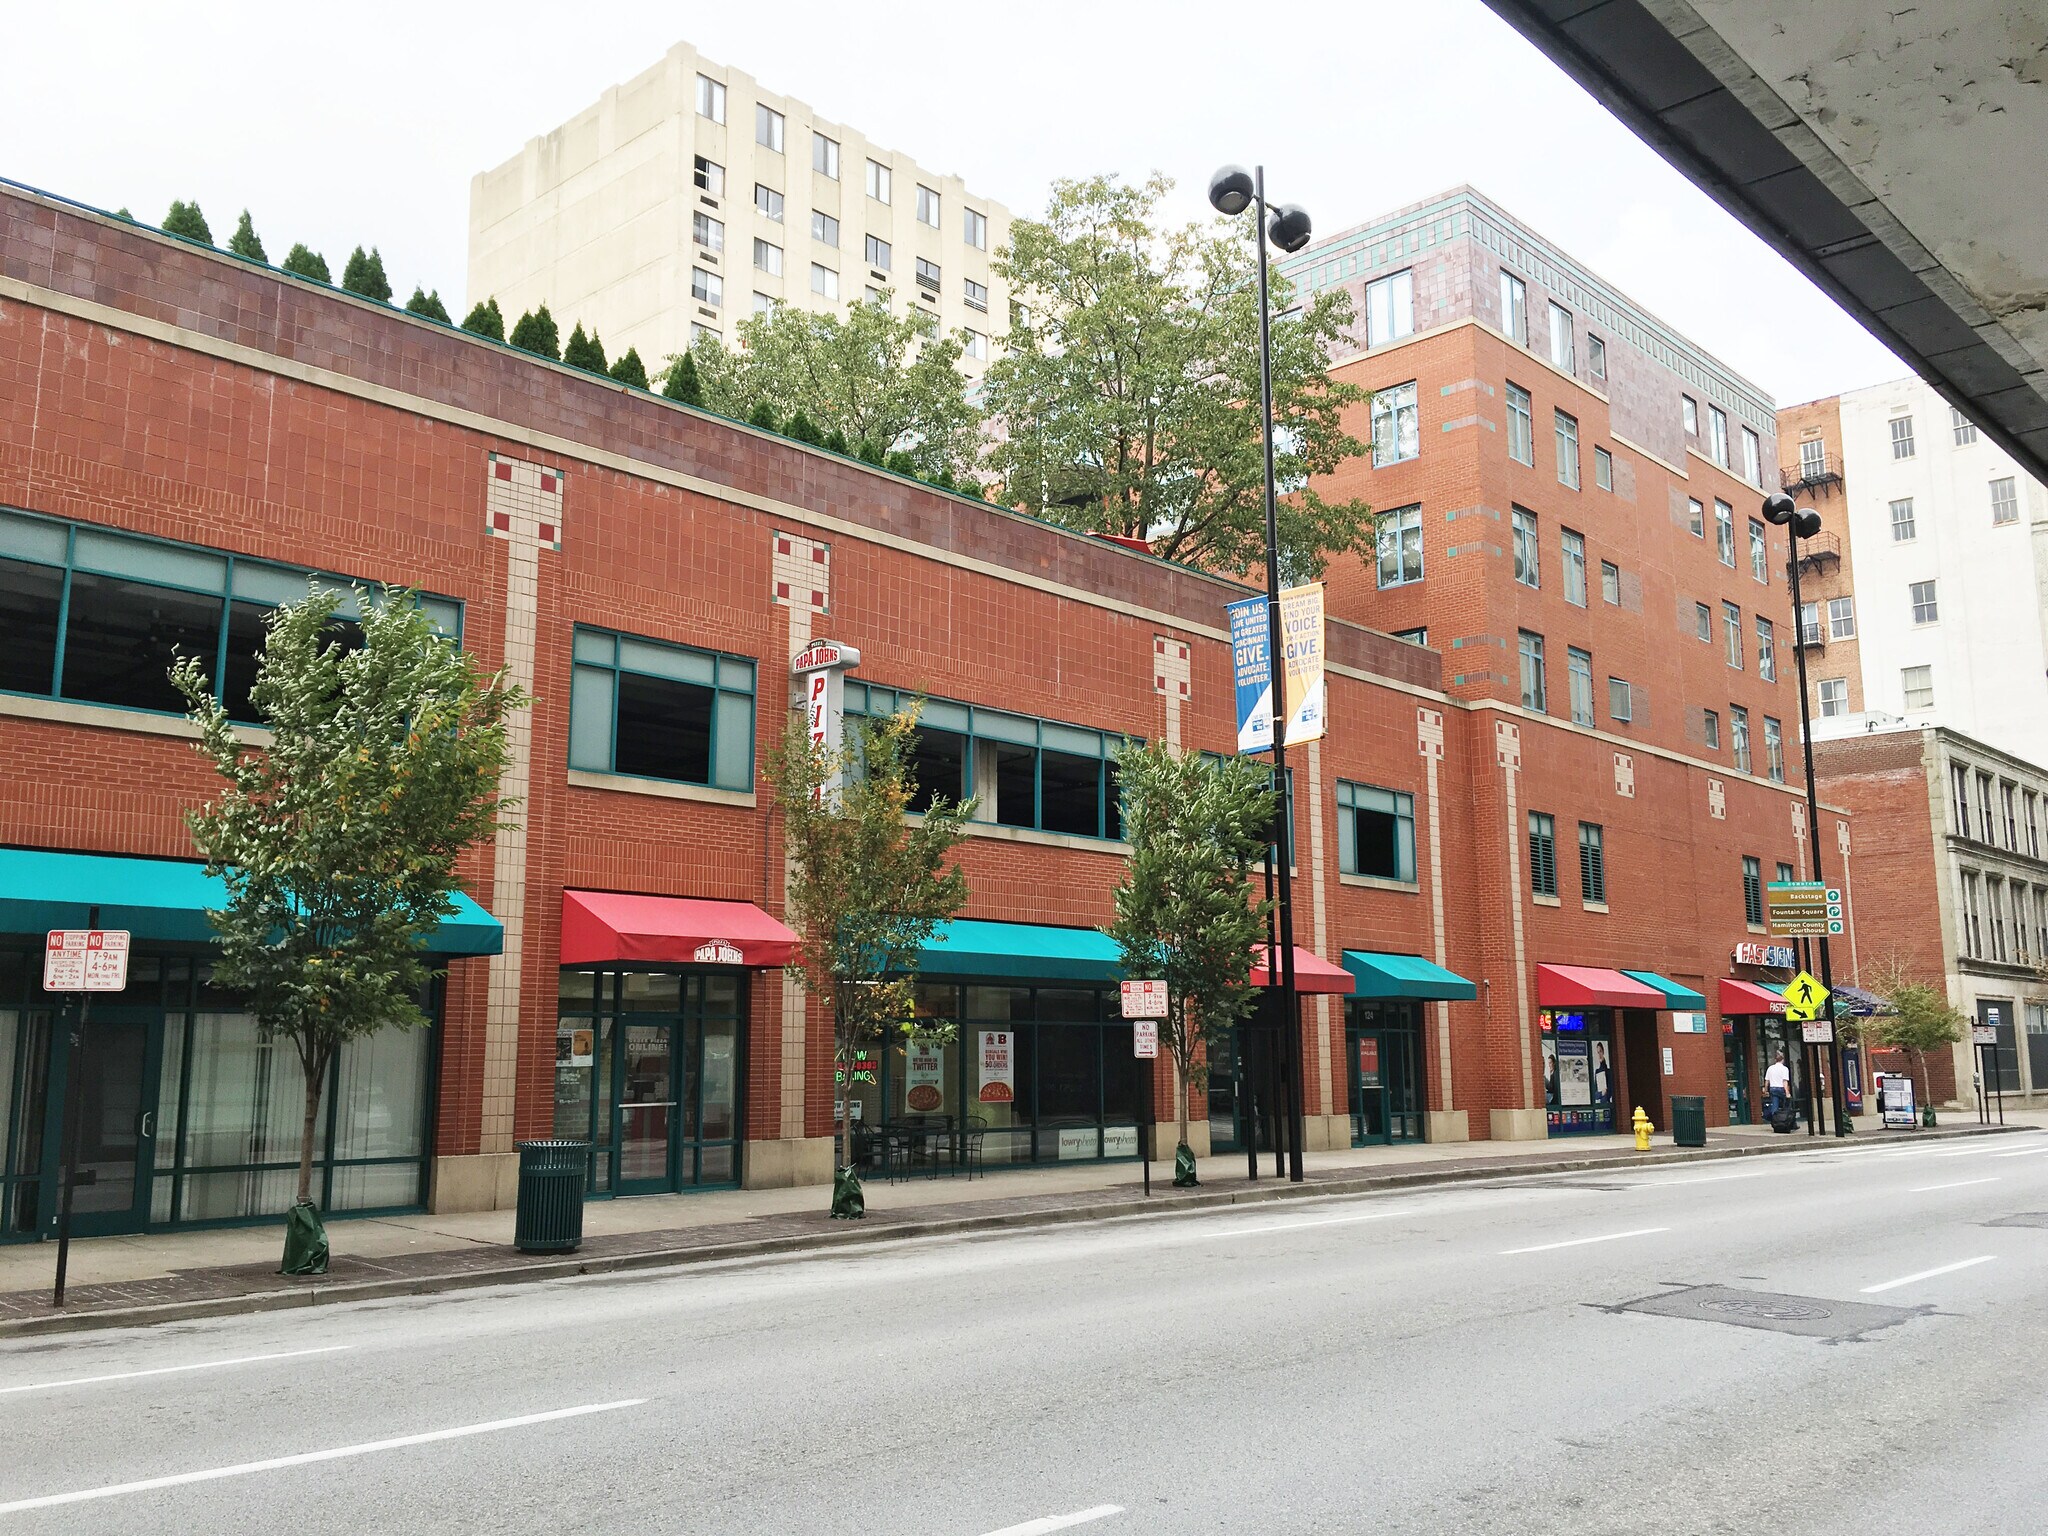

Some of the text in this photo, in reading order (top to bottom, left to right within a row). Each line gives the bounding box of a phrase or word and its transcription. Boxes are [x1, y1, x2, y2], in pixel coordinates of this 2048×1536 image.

[1231, 602, 1267, 620] JOIN US.
[1283, 599, 1305, 611] DREAM
[1284, 604, 1320, 620] FIND YOUR
[1233, 614, 1267, 629] LIVE UNITED
[1285, 615, 1321, 634] VOICE.
[1234, 623, 1267, 639] IN GREATER
[1235, 634, 1268, 648] CINCINNATI.
[1236, 644, 1269, 666] GIVE.
[1286, 638, 1321, 660] GIVE.
[796, 651, 813, 669] PAPA
[1237, 662, 1270, 677] ADVOCATE.
[50, 935, 62, 947] NO
[89, 935, 102, 947] NO
[52, 950, 82, 958] ANYTIME
[93, 951, 118, 960] 7-9AM
[696, 946, 717, 961] PAPA
[1741, 943, 1796, 967] FASTSIGNS
[91, 962, 118, 971] 4-6PM
[628, 1043, 668, 1052] ONLINE!
[913, 1062, 938, 1071] TWITTER
